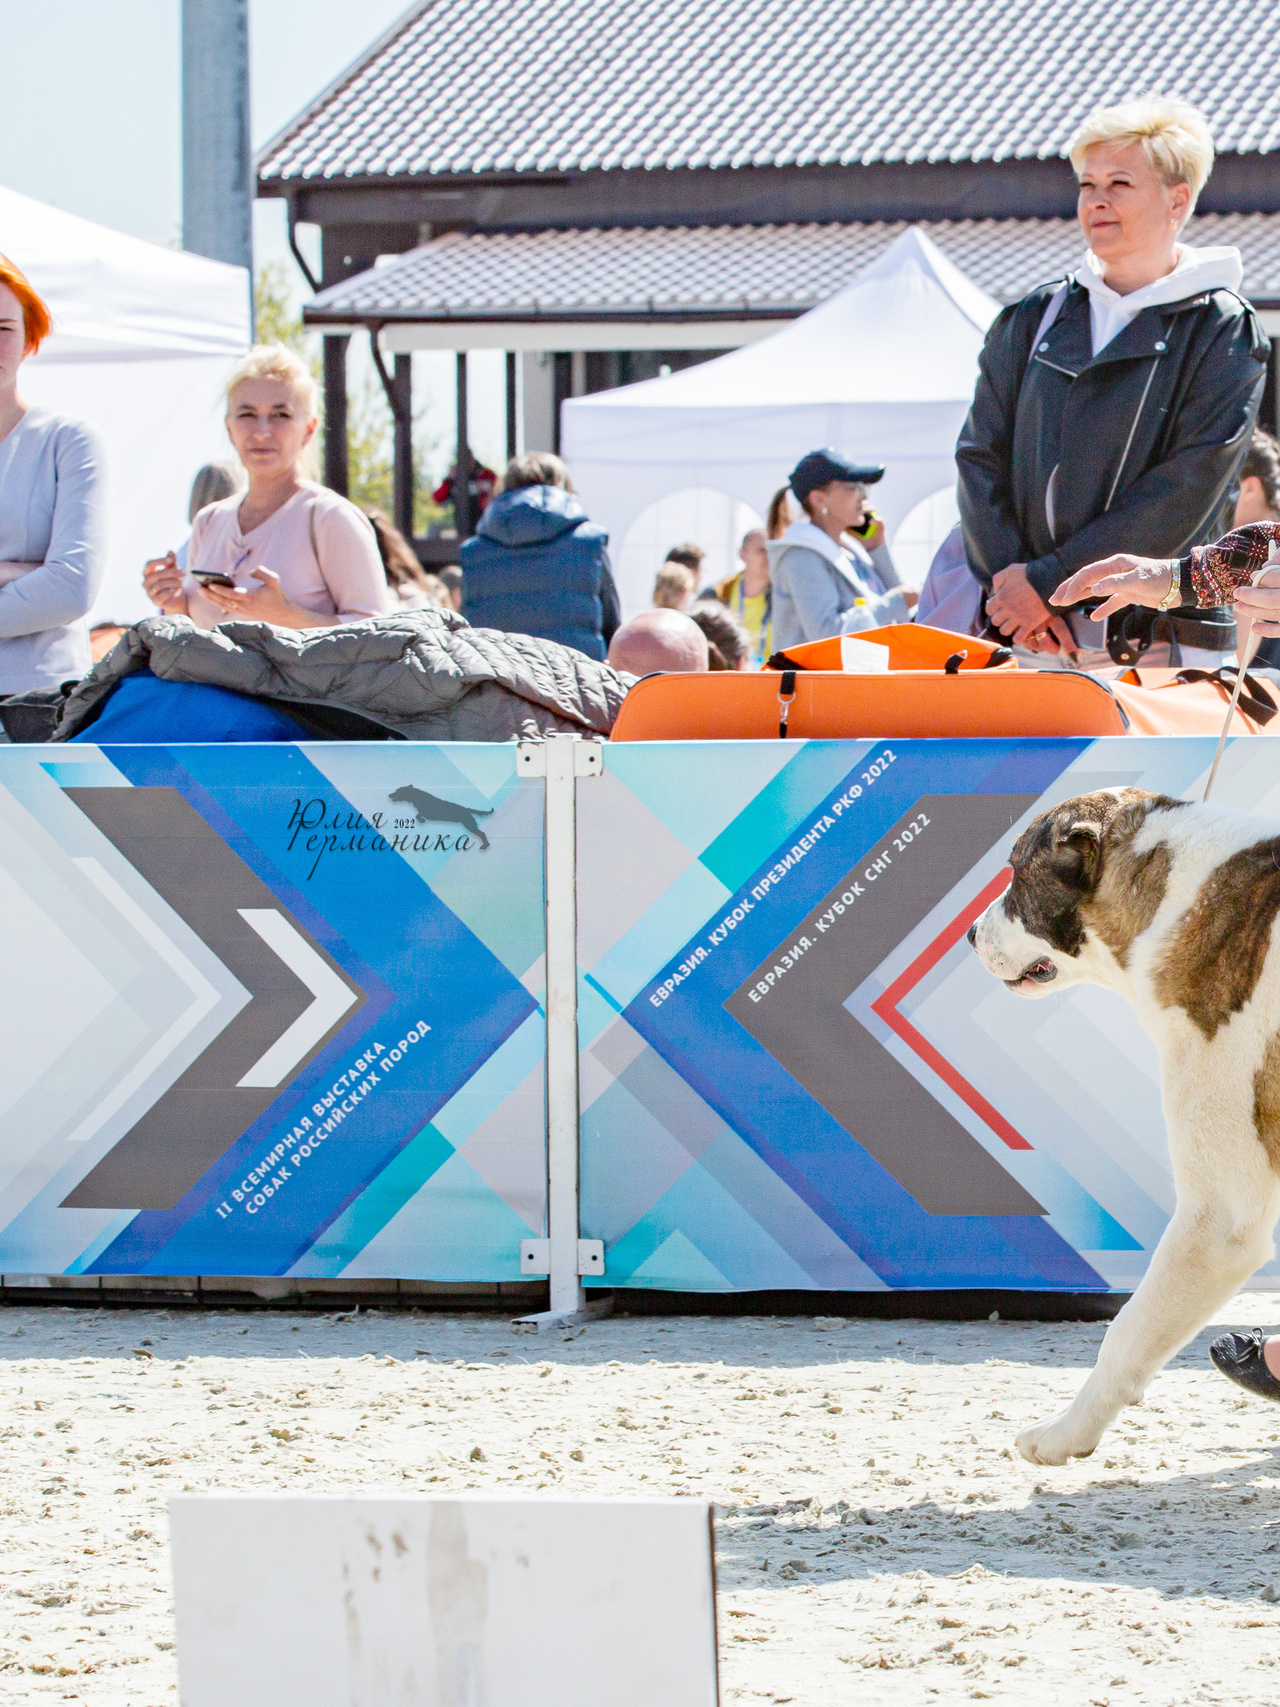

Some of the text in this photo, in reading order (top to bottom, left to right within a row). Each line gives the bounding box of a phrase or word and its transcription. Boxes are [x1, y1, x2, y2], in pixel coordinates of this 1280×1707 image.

[650, 749, 897, 1008] ЕВРАЗИЯ. КУБОК ПРЕЗИДЕНТА РКФ 2022
[748, 813, 931, 1003] ЕВРАЗИЯ. КУБОК СНГ 2022
[215, 1042, 386, 1219] II ВСЕМИРНАЯ ВЫСТАВКА
[245, 1020, 432, 1215] СОБАК РОССИЙСКИХ ПОРОД
